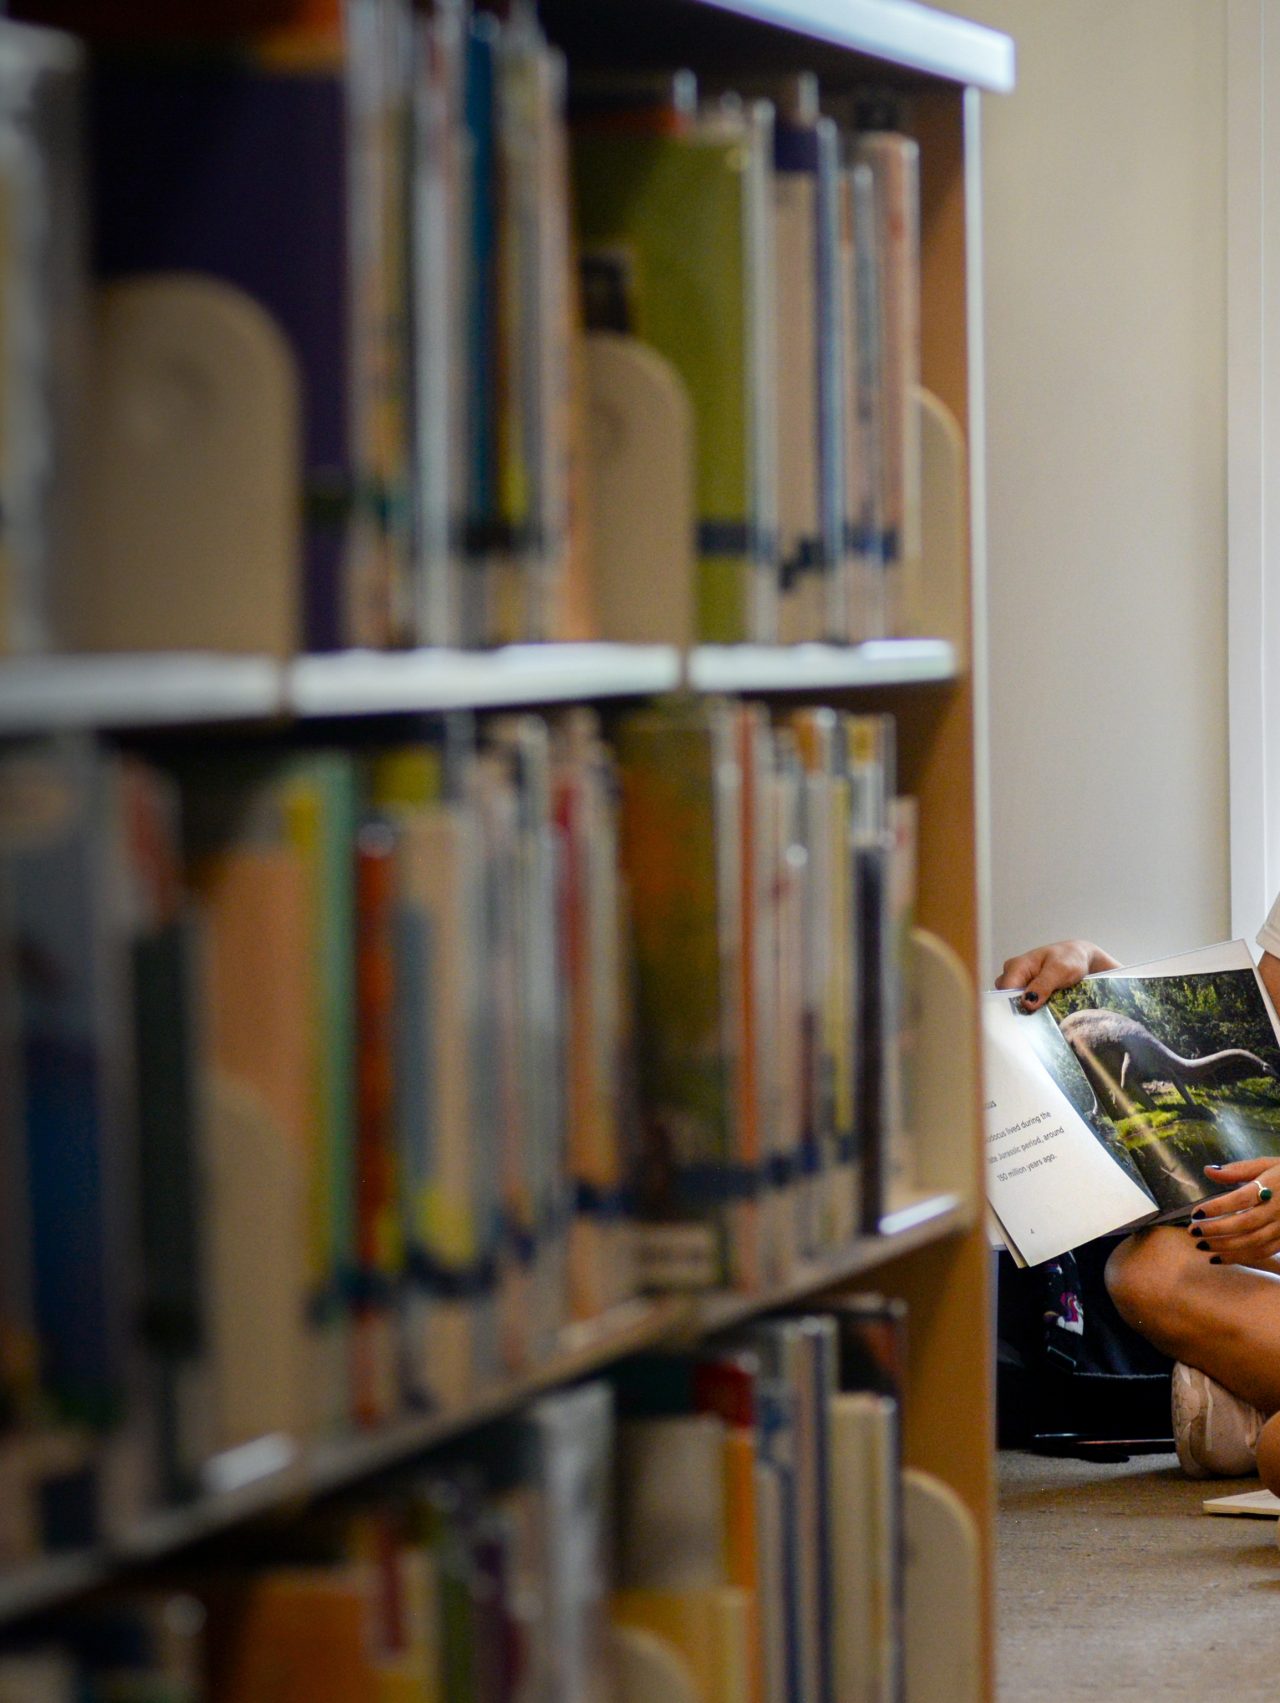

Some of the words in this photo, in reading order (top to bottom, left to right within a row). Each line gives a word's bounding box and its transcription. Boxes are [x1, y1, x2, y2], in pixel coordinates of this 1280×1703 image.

[1005, 1123, 1021, 1135] lived
[1021, 1115, 1042, 1129] during
[1040, 1111, 1052, 1121] the
[1043, 1125, 1064, 1141] around
[1008, 1164, 1027, 1178] million
[1026, 1158, 1043, 1172] years
